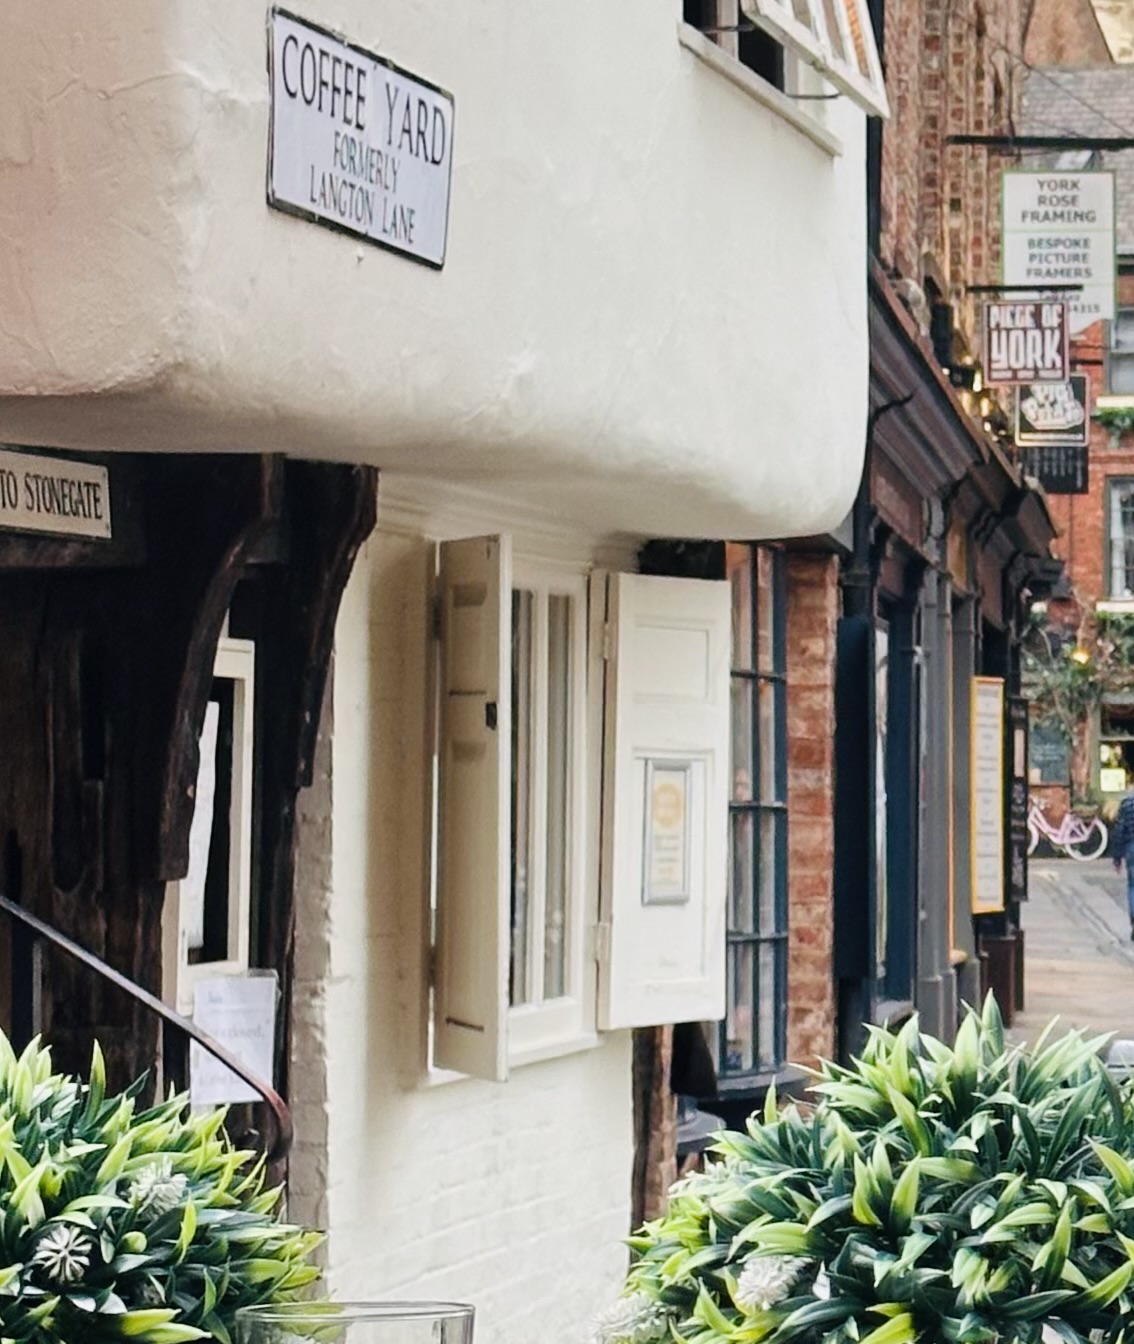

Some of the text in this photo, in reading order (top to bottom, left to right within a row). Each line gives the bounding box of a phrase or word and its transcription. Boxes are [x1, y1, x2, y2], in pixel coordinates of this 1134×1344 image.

[282, 34, 446, 167] COFFEE YARD
[333, 131, 400, 194] FORMERLY
[1037, 179, 1081, 192] YORK
[310, 164, 416, 244] LANGTON LANE
[1037, 194, 1080, 207] ROSE
[1021, 210, 1097, 224] FRAMING
[1027, 237, 1091, 250] BESPOKE
[1028, 252, 1090, 264] PICTURE
[1025, 267, 1093, 279] FRAMERS
[1041, 304, 1063, 329] OF
[990, 329, 1063, 370] YORK
[0, 468, 103, 521] TO STONEGATE
